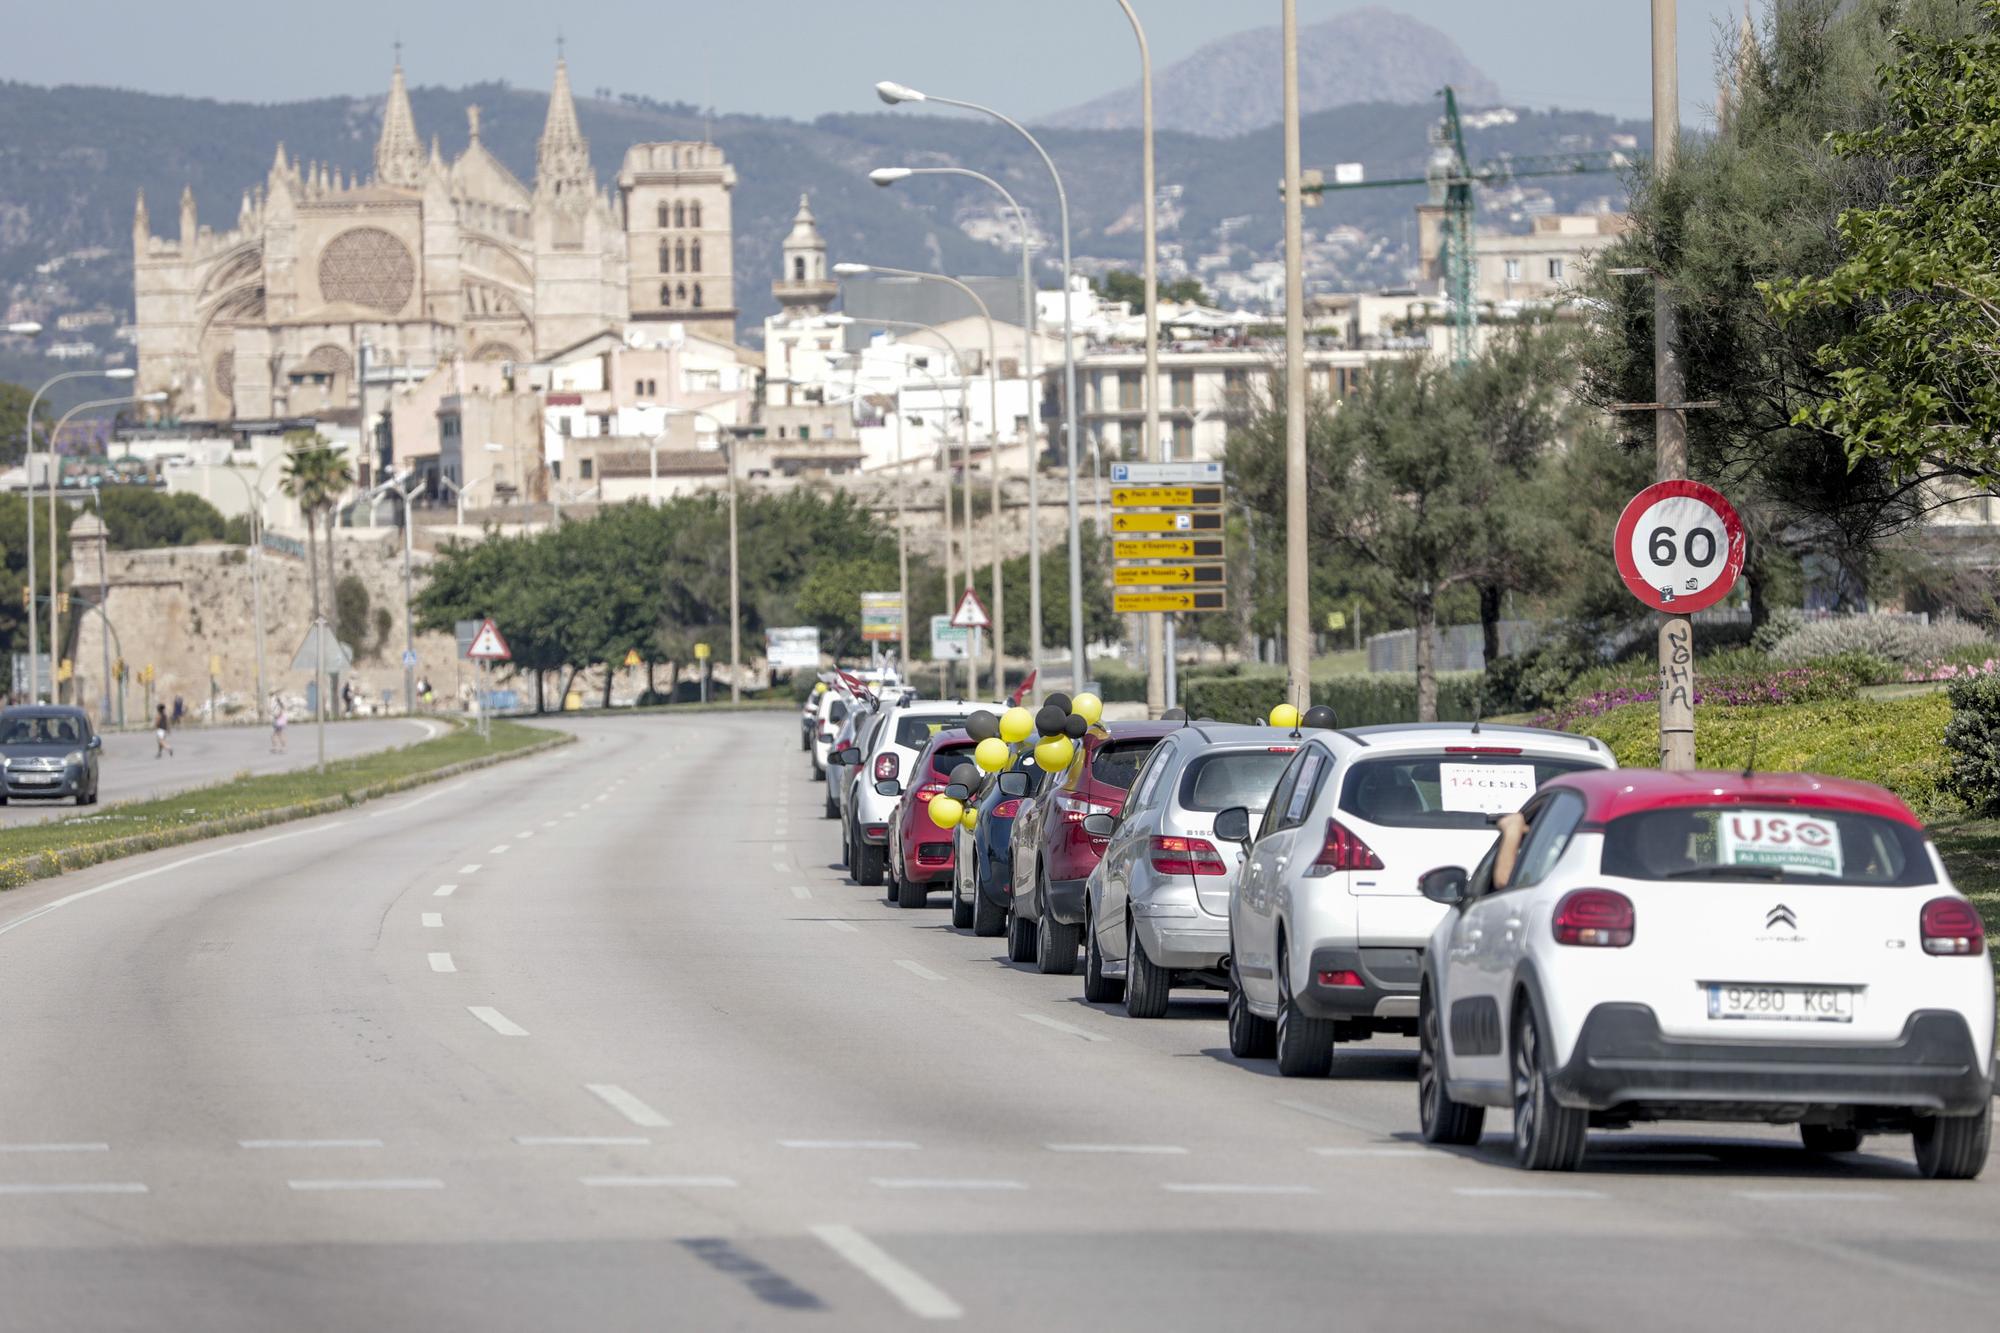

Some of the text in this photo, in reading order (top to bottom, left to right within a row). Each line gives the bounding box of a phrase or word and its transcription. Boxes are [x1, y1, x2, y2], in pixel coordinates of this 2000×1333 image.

[1649, 526, 1716, 568] 60
[1727, 988, 1845, 1014] 9280 KGL
